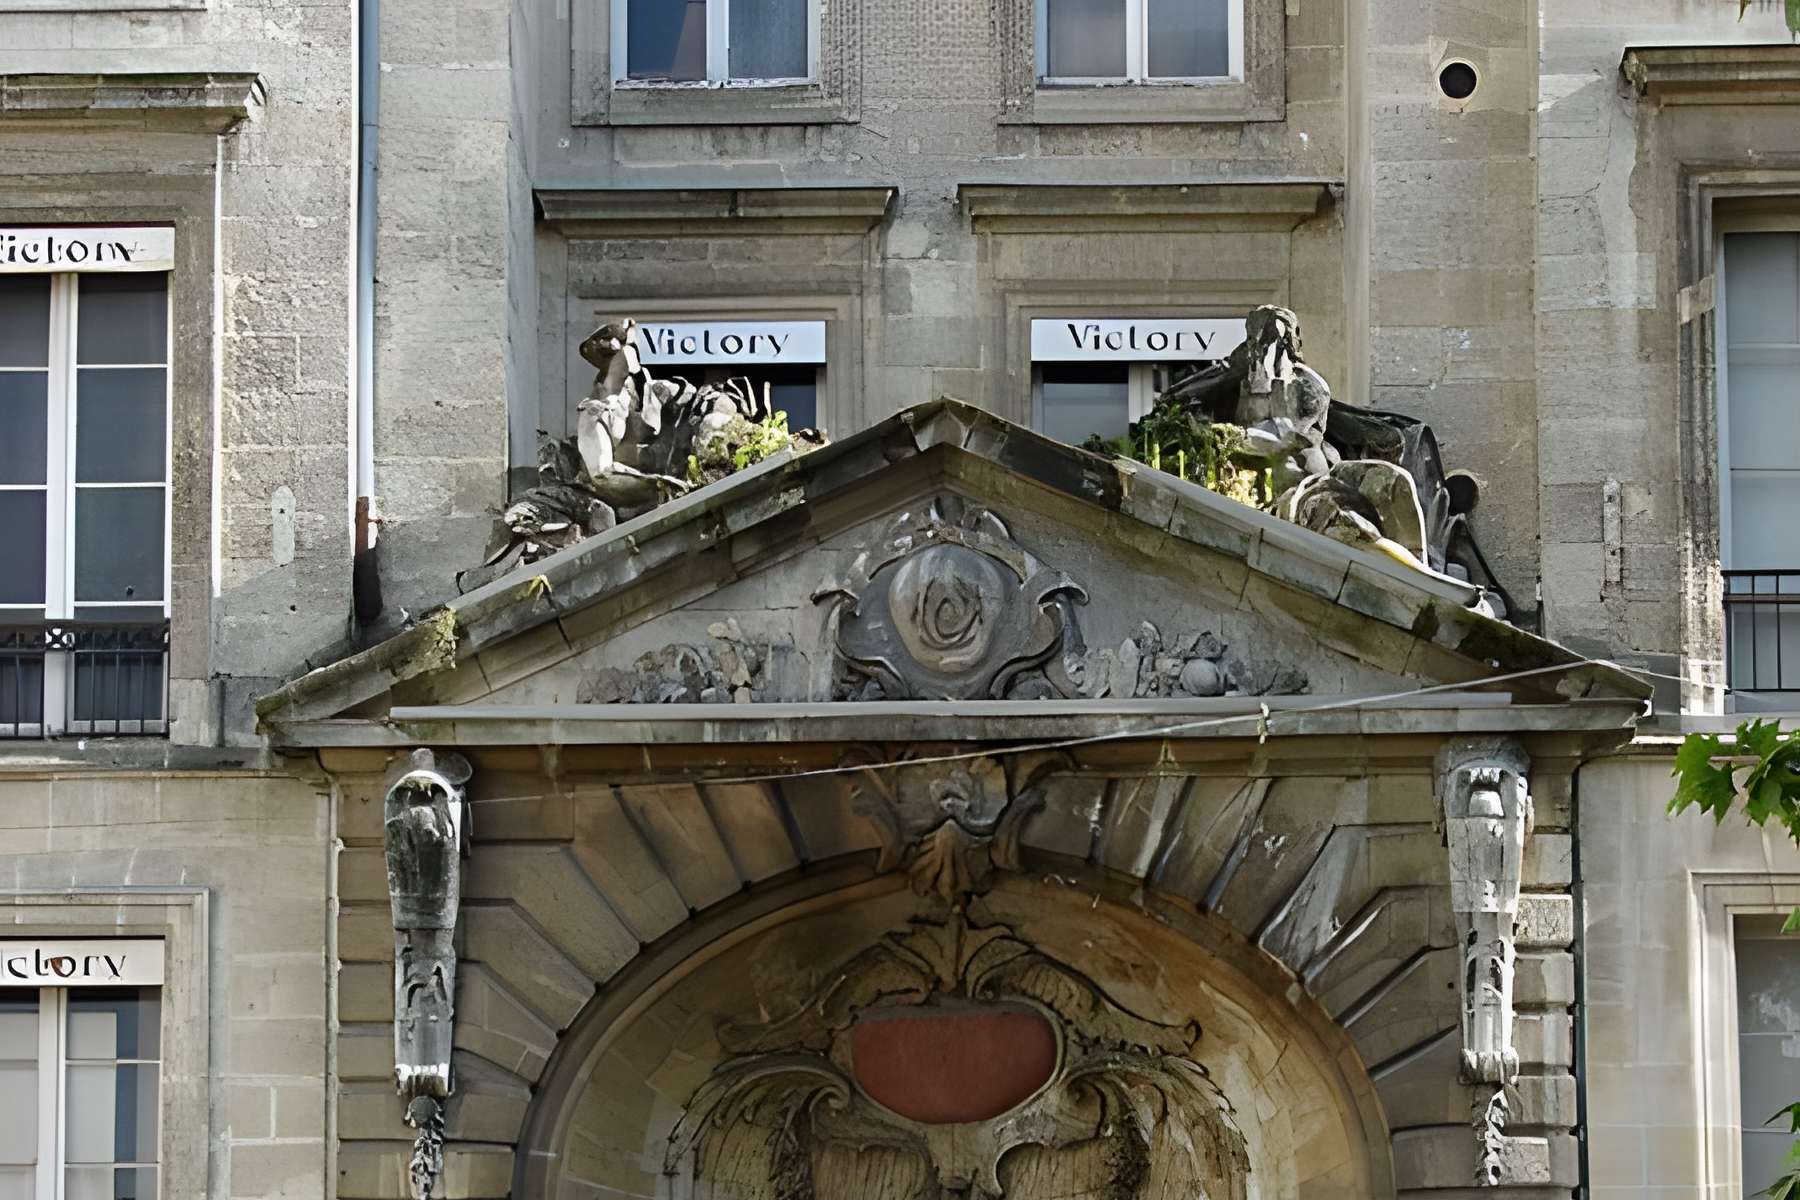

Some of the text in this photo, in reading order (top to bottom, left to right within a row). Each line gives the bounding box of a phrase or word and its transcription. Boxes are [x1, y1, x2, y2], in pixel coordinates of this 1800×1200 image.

[0, 235, 138, 264] ictory
[642, 328, 789, 357] Victory
[1067, 323, 1216, 353] Victory
[0, 948, 127, 980] ctory
